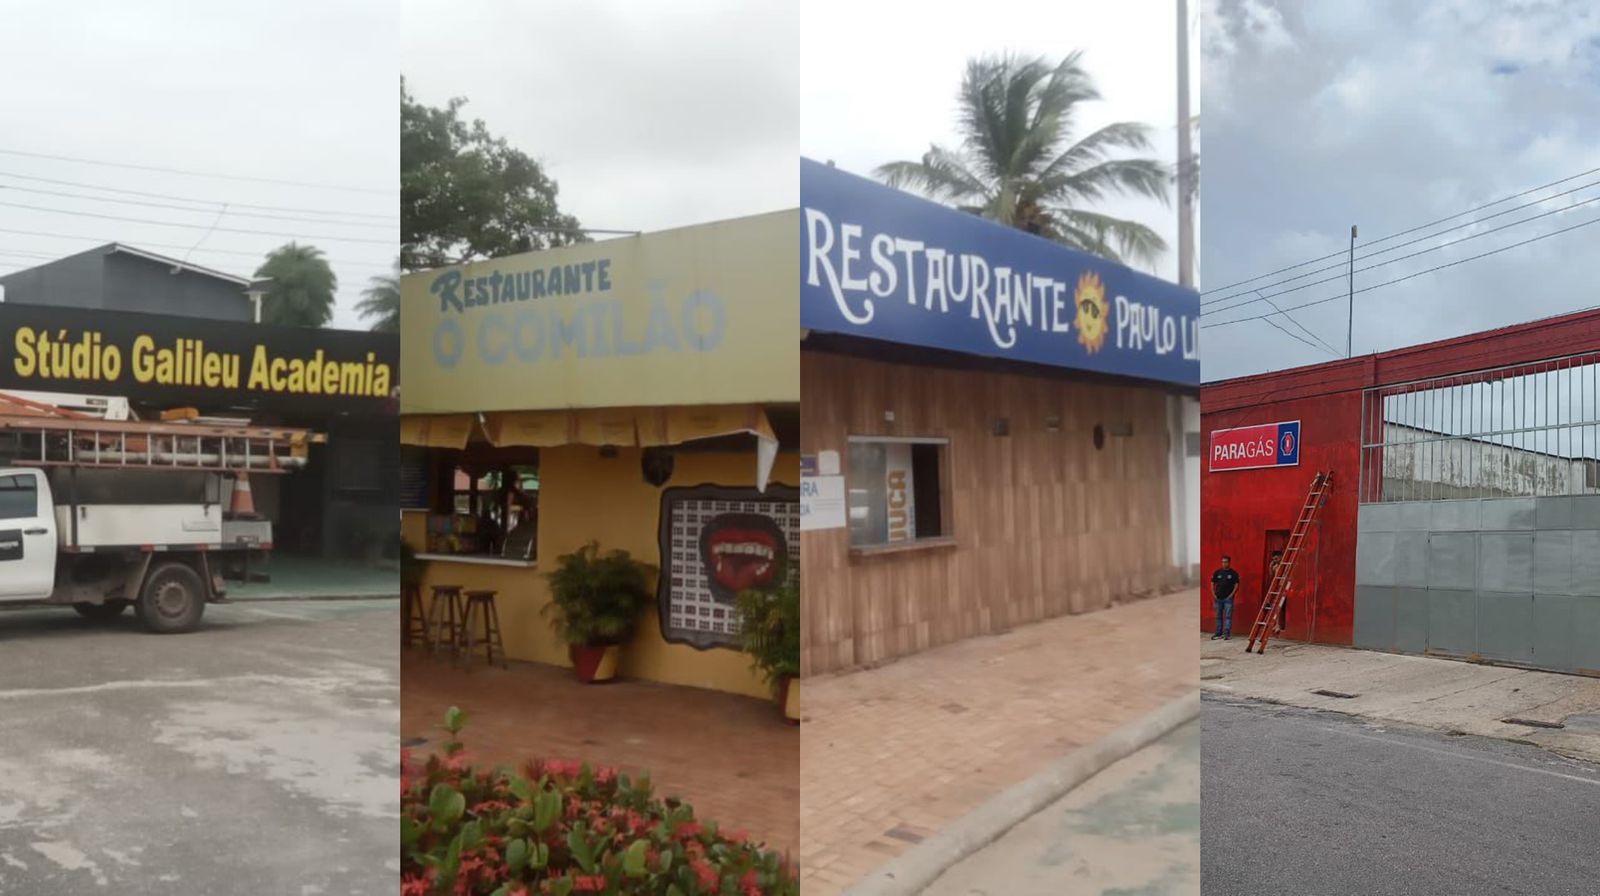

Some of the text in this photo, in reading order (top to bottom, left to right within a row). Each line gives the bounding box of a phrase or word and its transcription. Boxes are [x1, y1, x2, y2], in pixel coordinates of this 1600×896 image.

[430, 259, 612, 314] RESTAURANTE
[804, 207, 1070, 349] RESTAURANTE
[1115, 296, 1177, 355] PAULO
[432, 279, 728, 368] O COMILÃO
[14, 326, 391, 397] Stúdio Galileu Academia
[1214, 435, 1275, 461] PARAGÁS
